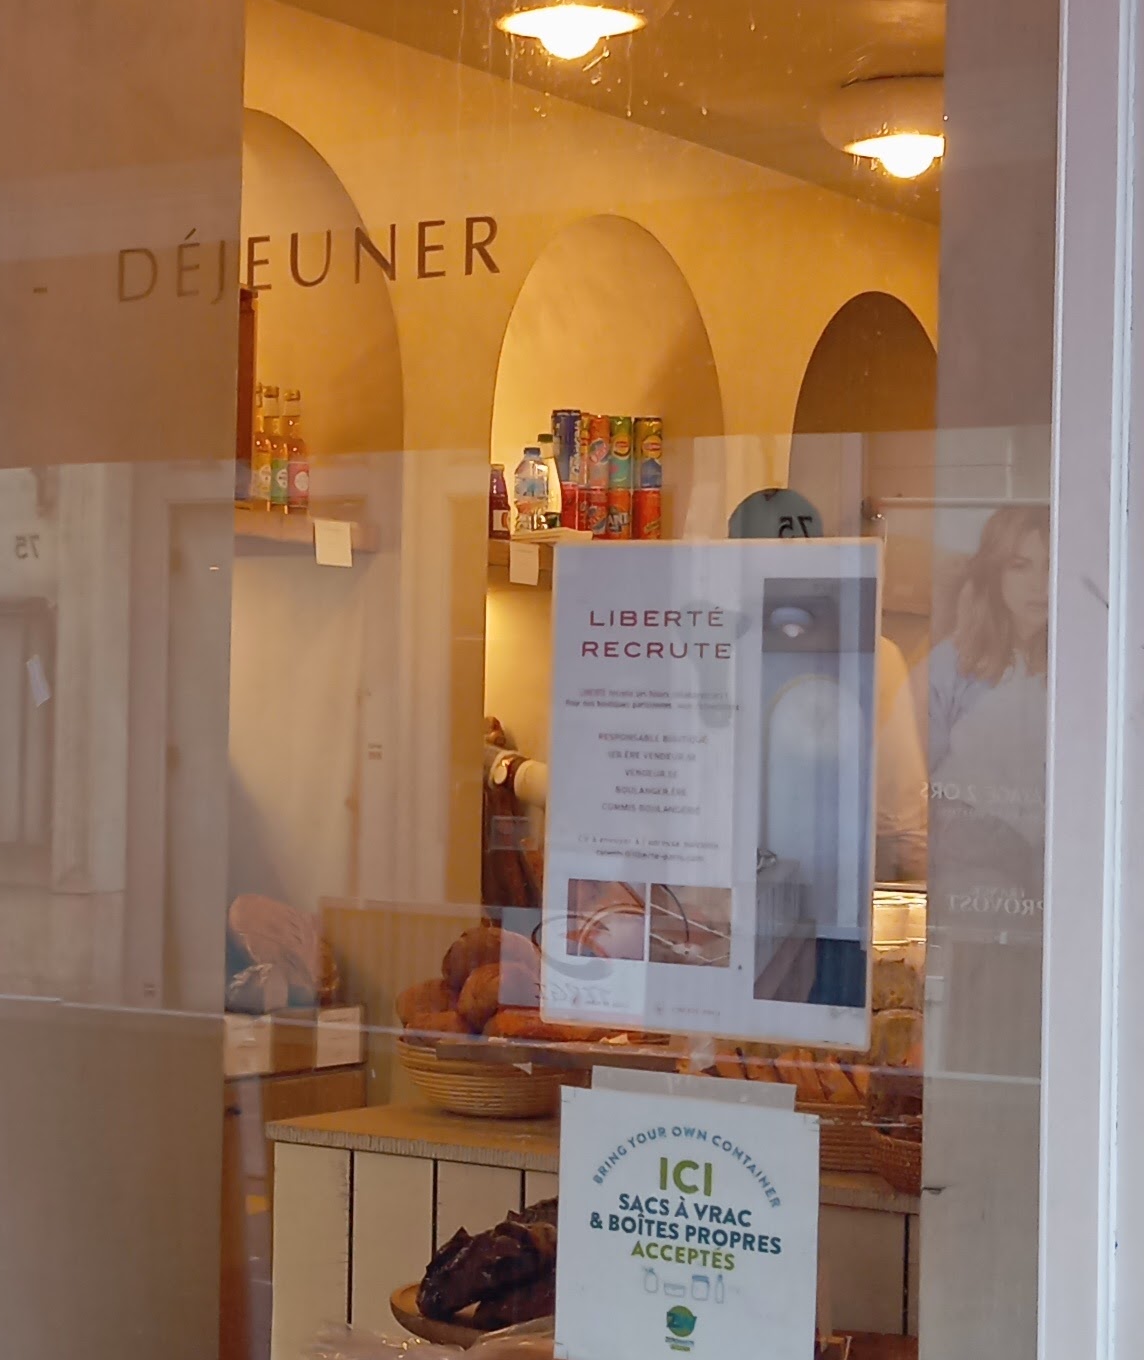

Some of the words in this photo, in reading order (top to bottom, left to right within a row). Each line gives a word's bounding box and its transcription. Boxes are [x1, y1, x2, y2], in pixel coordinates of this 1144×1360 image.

[117, 216, 501, 304] DÉJEUNER
[589, 606, 724, 628] LIBERTÉ
[581, 641, 732, 660] RECRUTE
[592, 1143, 628, 1186] BRING
[627, 1126, 667, 1149] YOUR
[671, 1125, 708, 1142] OWN
[711, 1134, 782, 1209] CONTAINER
[659, 1156, 713, 1197] ICI
[618, 1192, 670, 1216] SACS
[674, 1196, 689, 1219] À
[693, 1203, 753, 1228] VRAC
[589, 1212, 604, 1230] &
[607, 1211, 680, 1240] BOÎTES
[684, 1224, 782, 1255] PROPRES
[630, 1240, 736, 1271] ACCEPTÉS
